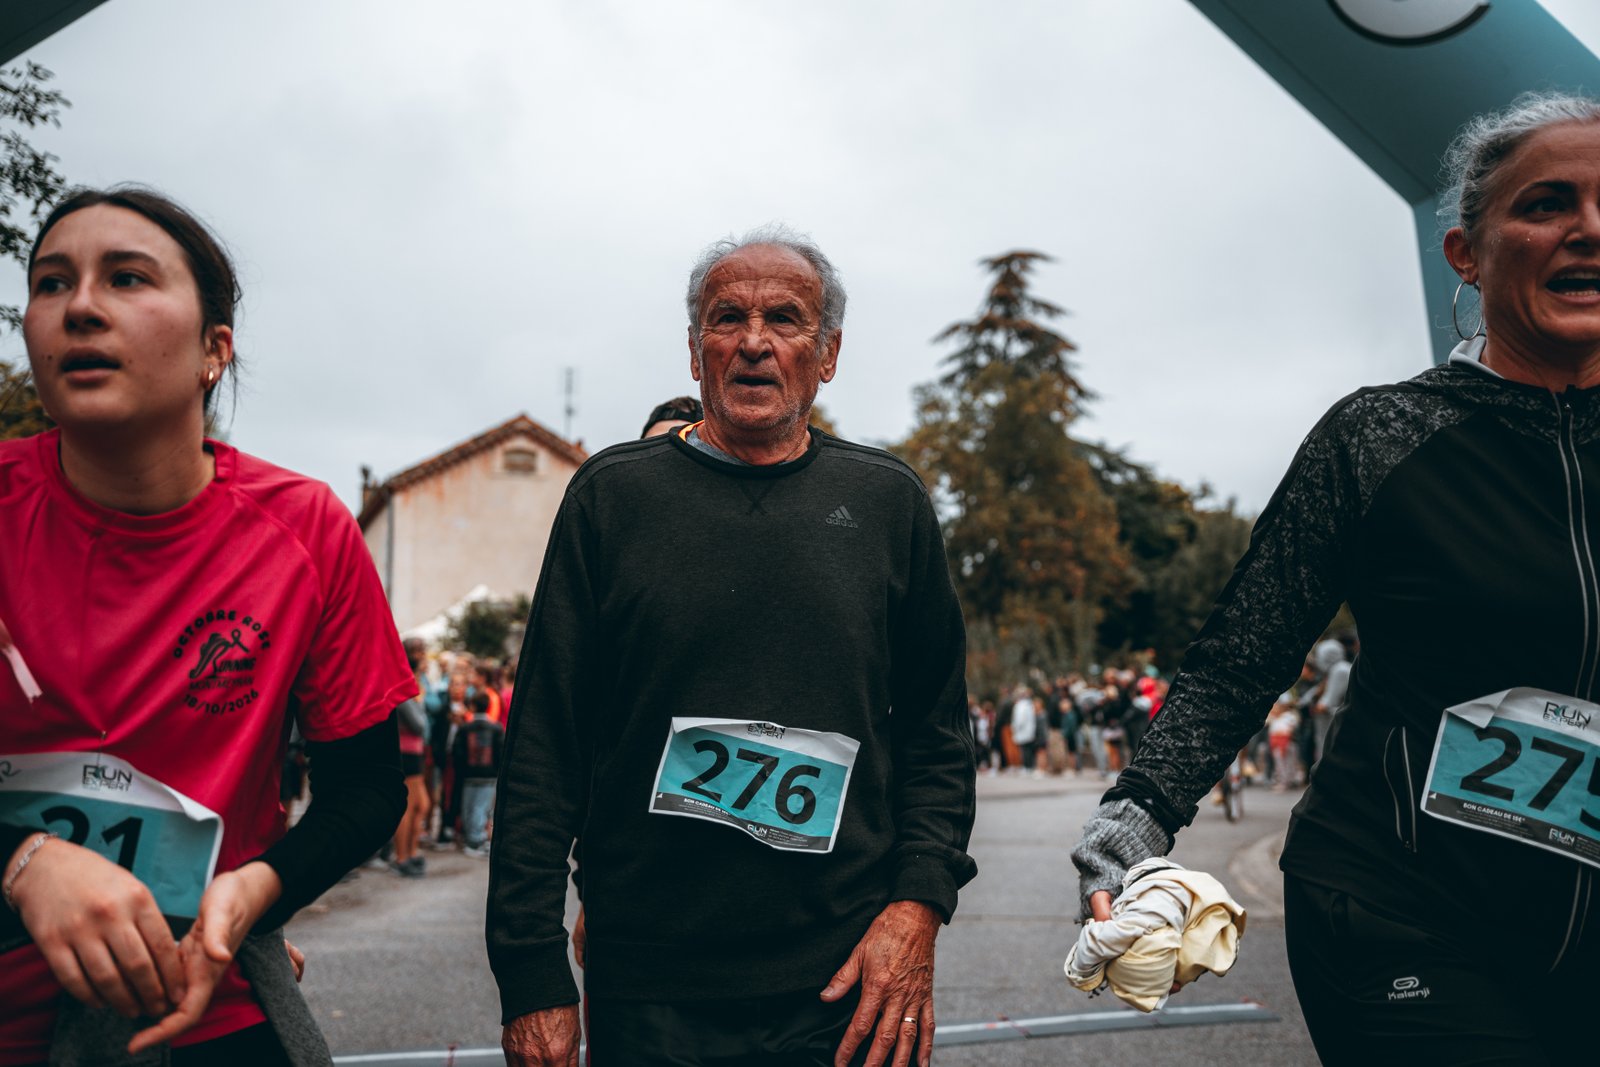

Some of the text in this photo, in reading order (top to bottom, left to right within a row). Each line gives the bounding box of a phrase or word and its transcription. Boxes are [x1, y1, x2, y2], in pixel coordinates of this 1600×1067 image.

[825, 517, 858, 528] adidas
[173, 609, 271, 659] OCTOBRE ROSE
[1543, 701, 1592, 725] RUN
[1543, 712, 1587, 731] EXPERT
[82, 764, 132, 785] RUN
[681, 739, 821, 825] 276
[1463, 802, 1477, 811] BON
[1477, 806, 1503, 817] CADEAU
[1549, 828, 1575, 844] RUN
